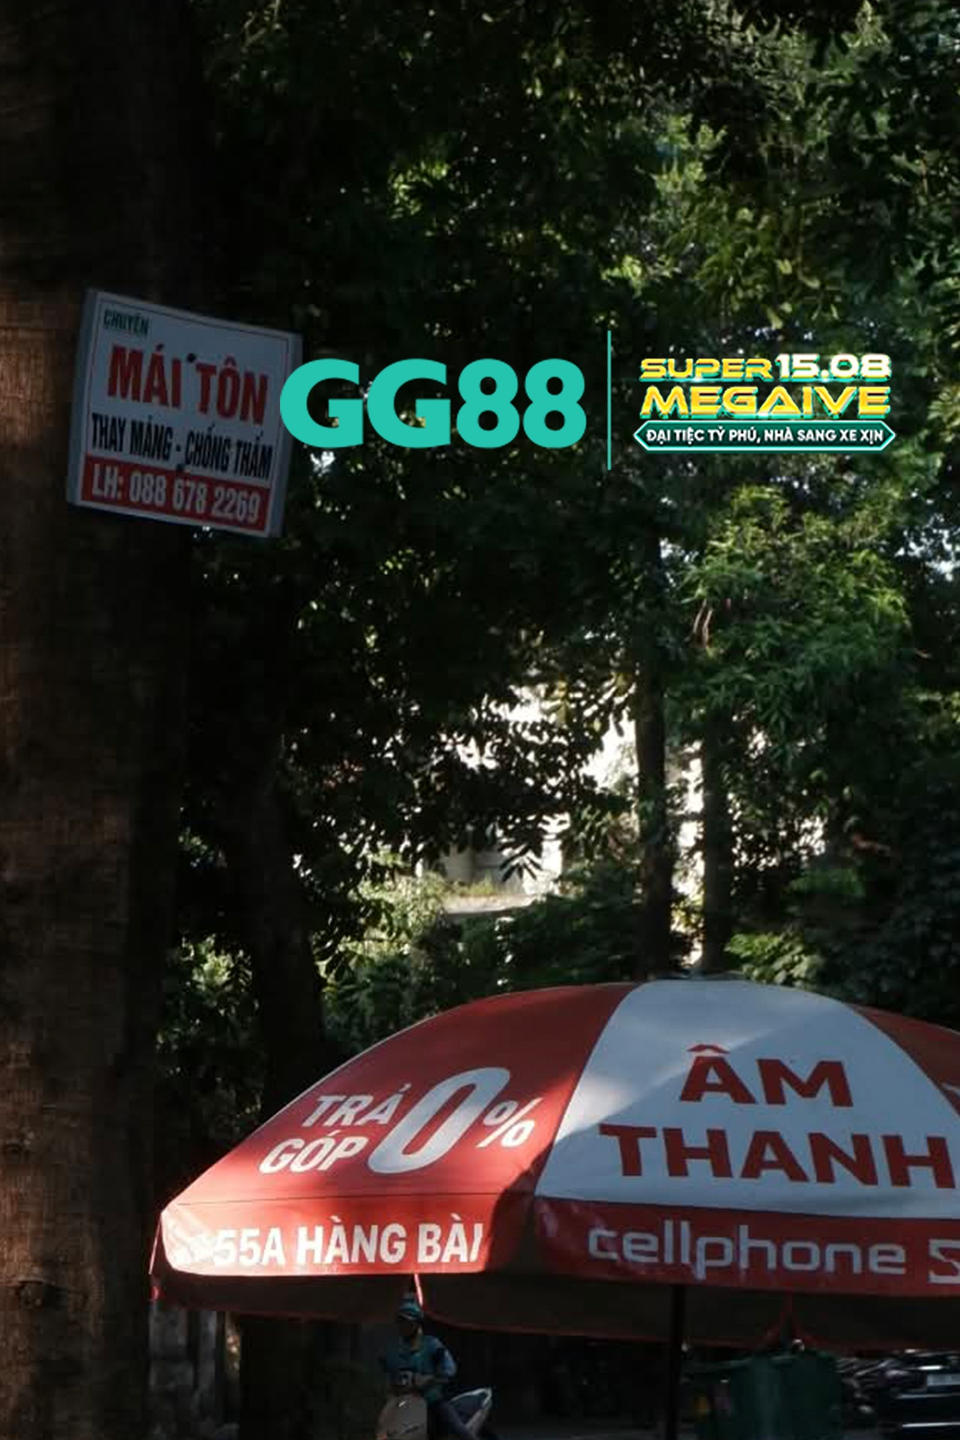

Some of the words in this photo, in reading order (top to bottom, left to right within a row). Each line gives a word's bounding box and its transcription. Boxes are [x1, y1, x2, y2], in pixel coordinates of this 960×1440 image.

[108, 343, 182, 410] MÁI
[194, 356, 269, 426] TÔN
[91, 413, 127, 452] THAY
[184, 423, 231, 473] CHỐNG
[91, 464, 124, 500] LH:
[129, 472, 167, 507] 088
[173, 479, 208, 515] 678
[211, 487, 261, 524] 2269
[679, 1043, 853, 1107] ÂM
[300, 1083, 413, 1128] TRẢ
[259, 1131, 370, 1175] GÓP
[599, 1123, 956, 1189] THANH
[296, 1214, 408, 1265] HÀNG
[416, 1212, 485, 1264] BÀI
[588, 1219, 907, 1281] cellphone
